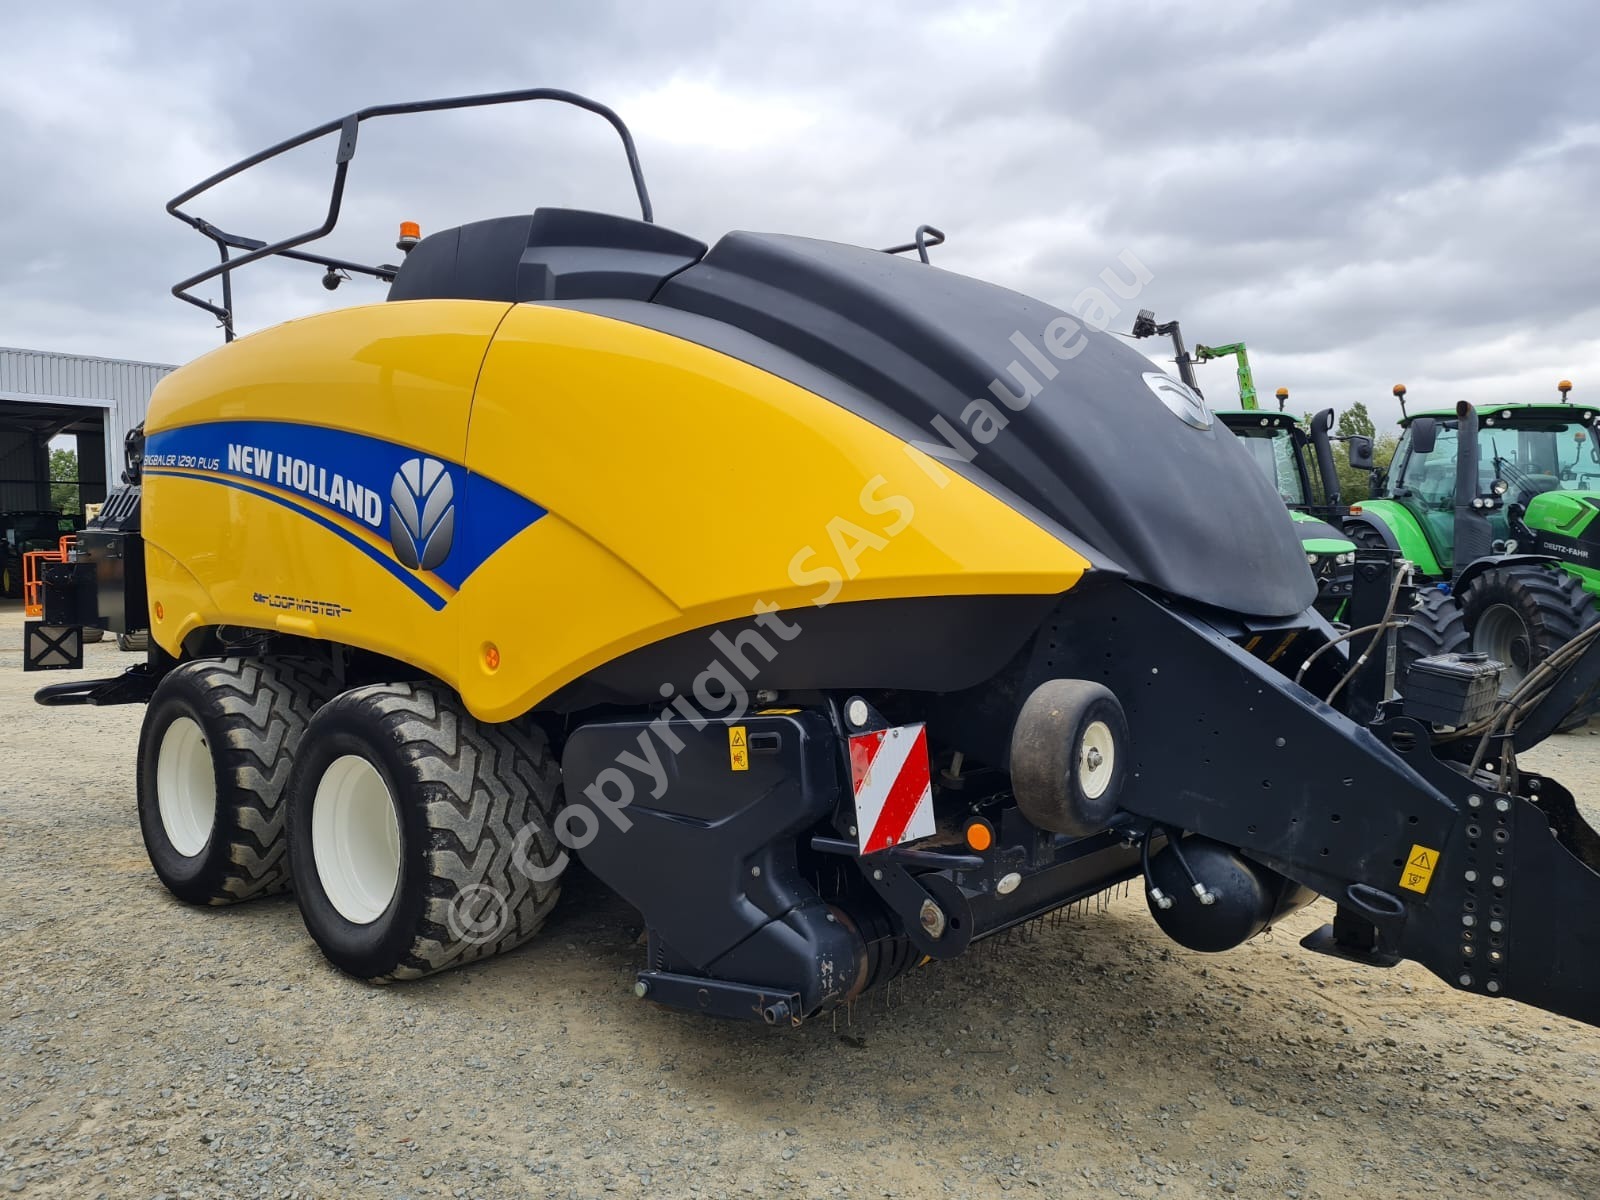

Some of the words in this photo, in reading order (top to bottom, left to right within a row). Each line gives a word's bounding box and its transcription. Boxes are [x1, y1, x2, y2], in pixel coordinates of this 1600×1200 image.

[144, 454, 177, 466] BIGBALER
[177, 455, 197, 468] 1290
[197, 456, 220, 471] PLUS
[227, 443, 272, 480] NEW
[276, 453, 383, 528] HOLLAND
[1543, 541, 1589, 559] DEUTZ-FAHR
